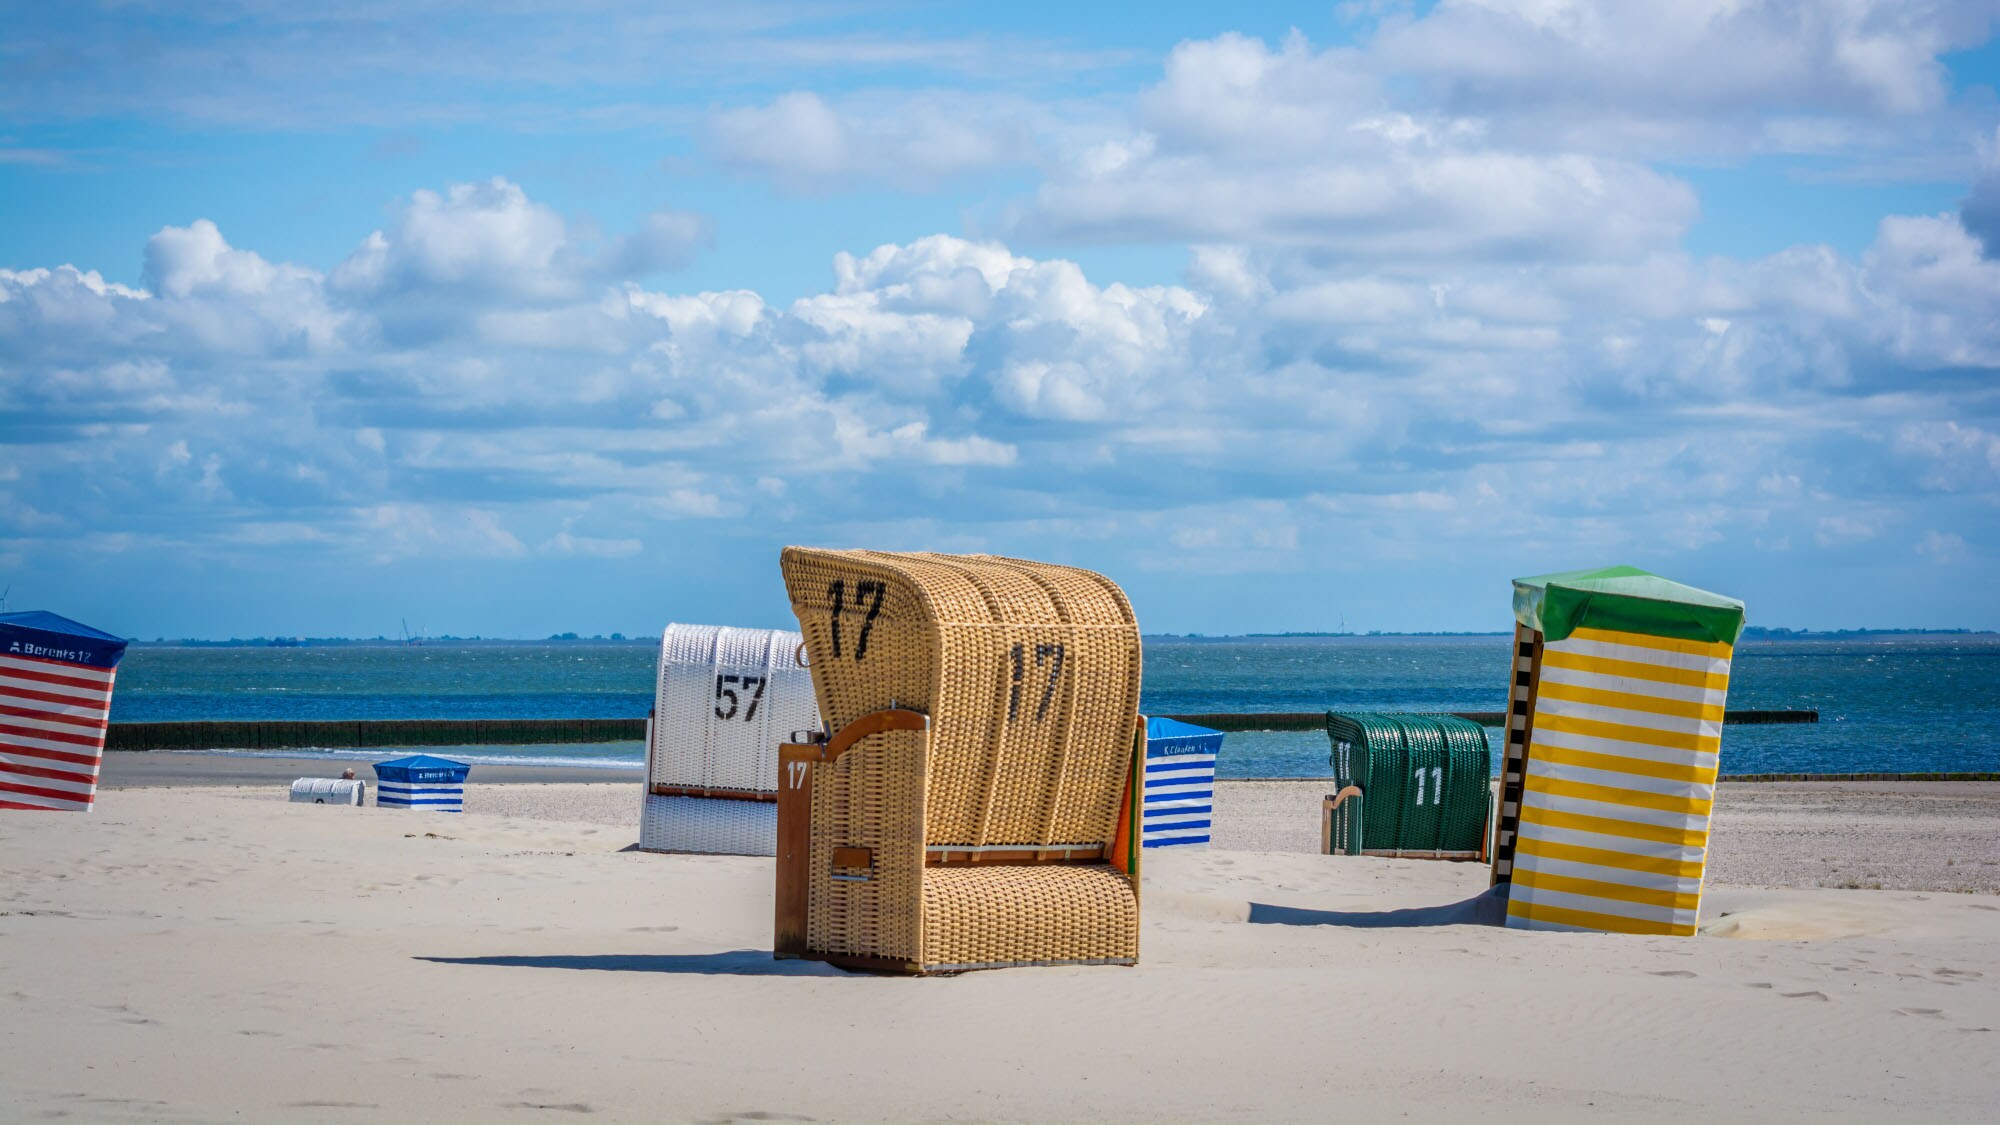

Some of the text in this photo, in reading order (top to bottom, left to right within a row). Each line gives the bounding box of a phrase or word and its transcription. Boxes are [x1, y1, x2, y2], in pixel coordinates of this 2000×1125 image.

[827, 579, 886, 661] 17
[715, 674, 766, 722] 57
[1008, 644, 1065, 721] 17
[787, 761, 808, 790] 17
[1339, 741, 1351, 780] 11
[1414, 767, 1442, 805] 11
